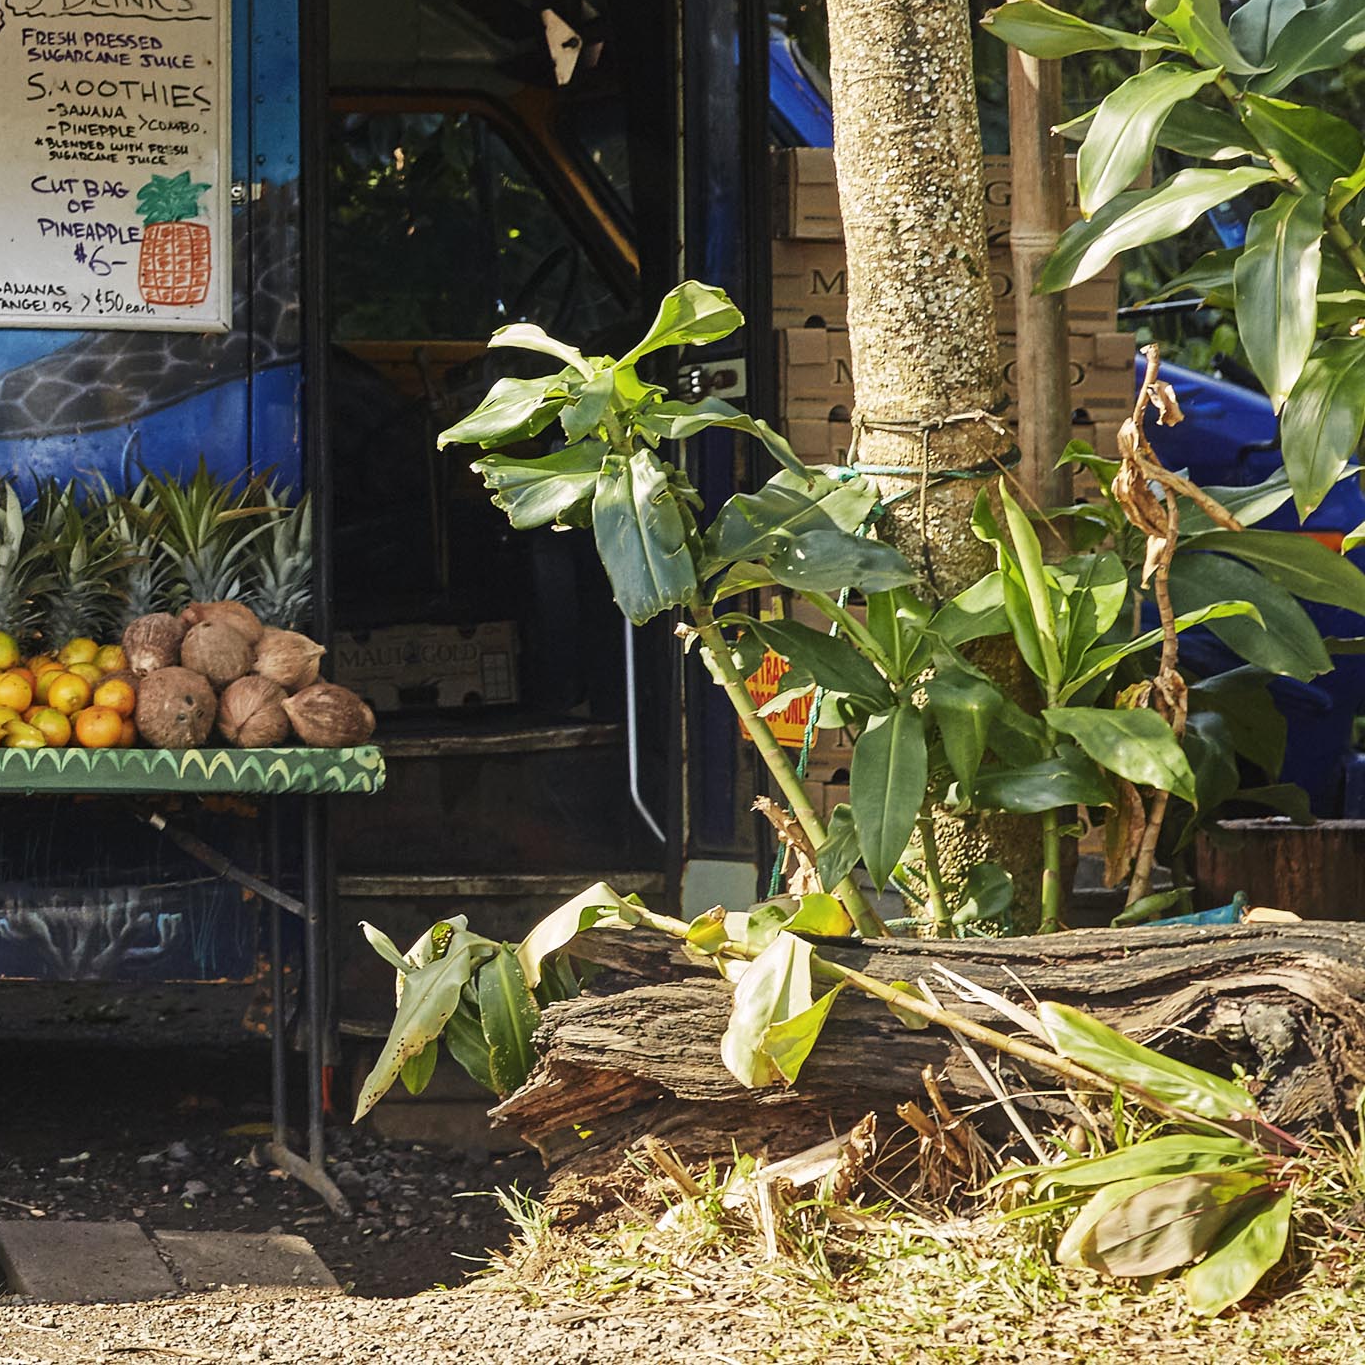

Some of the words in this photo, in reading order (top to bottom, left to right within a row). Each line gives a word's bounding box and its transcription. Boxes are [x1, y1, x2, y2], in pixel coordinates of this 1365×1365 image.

[22, 28, 76, 46] FRESH
[84, 32, 163, 49] PRESSED
[28, 48, 131, 65] SUGARCANE
[141, 55, 196, 68] JUICE
[111, 142, 143, 152] WITH
[49, 150, 118, 163] SUGARCANE
[127, 156, 168, 165] JUICE
[31, 176, 80, 194] CUT
[85, 181, 129, 198] BAG
[67, 200, 96, 213] OF
[38, 218, 144, 244] PINEAPPLE
[125, 303, 155, 314] each
[338, 648, 403, 668] MAUI
